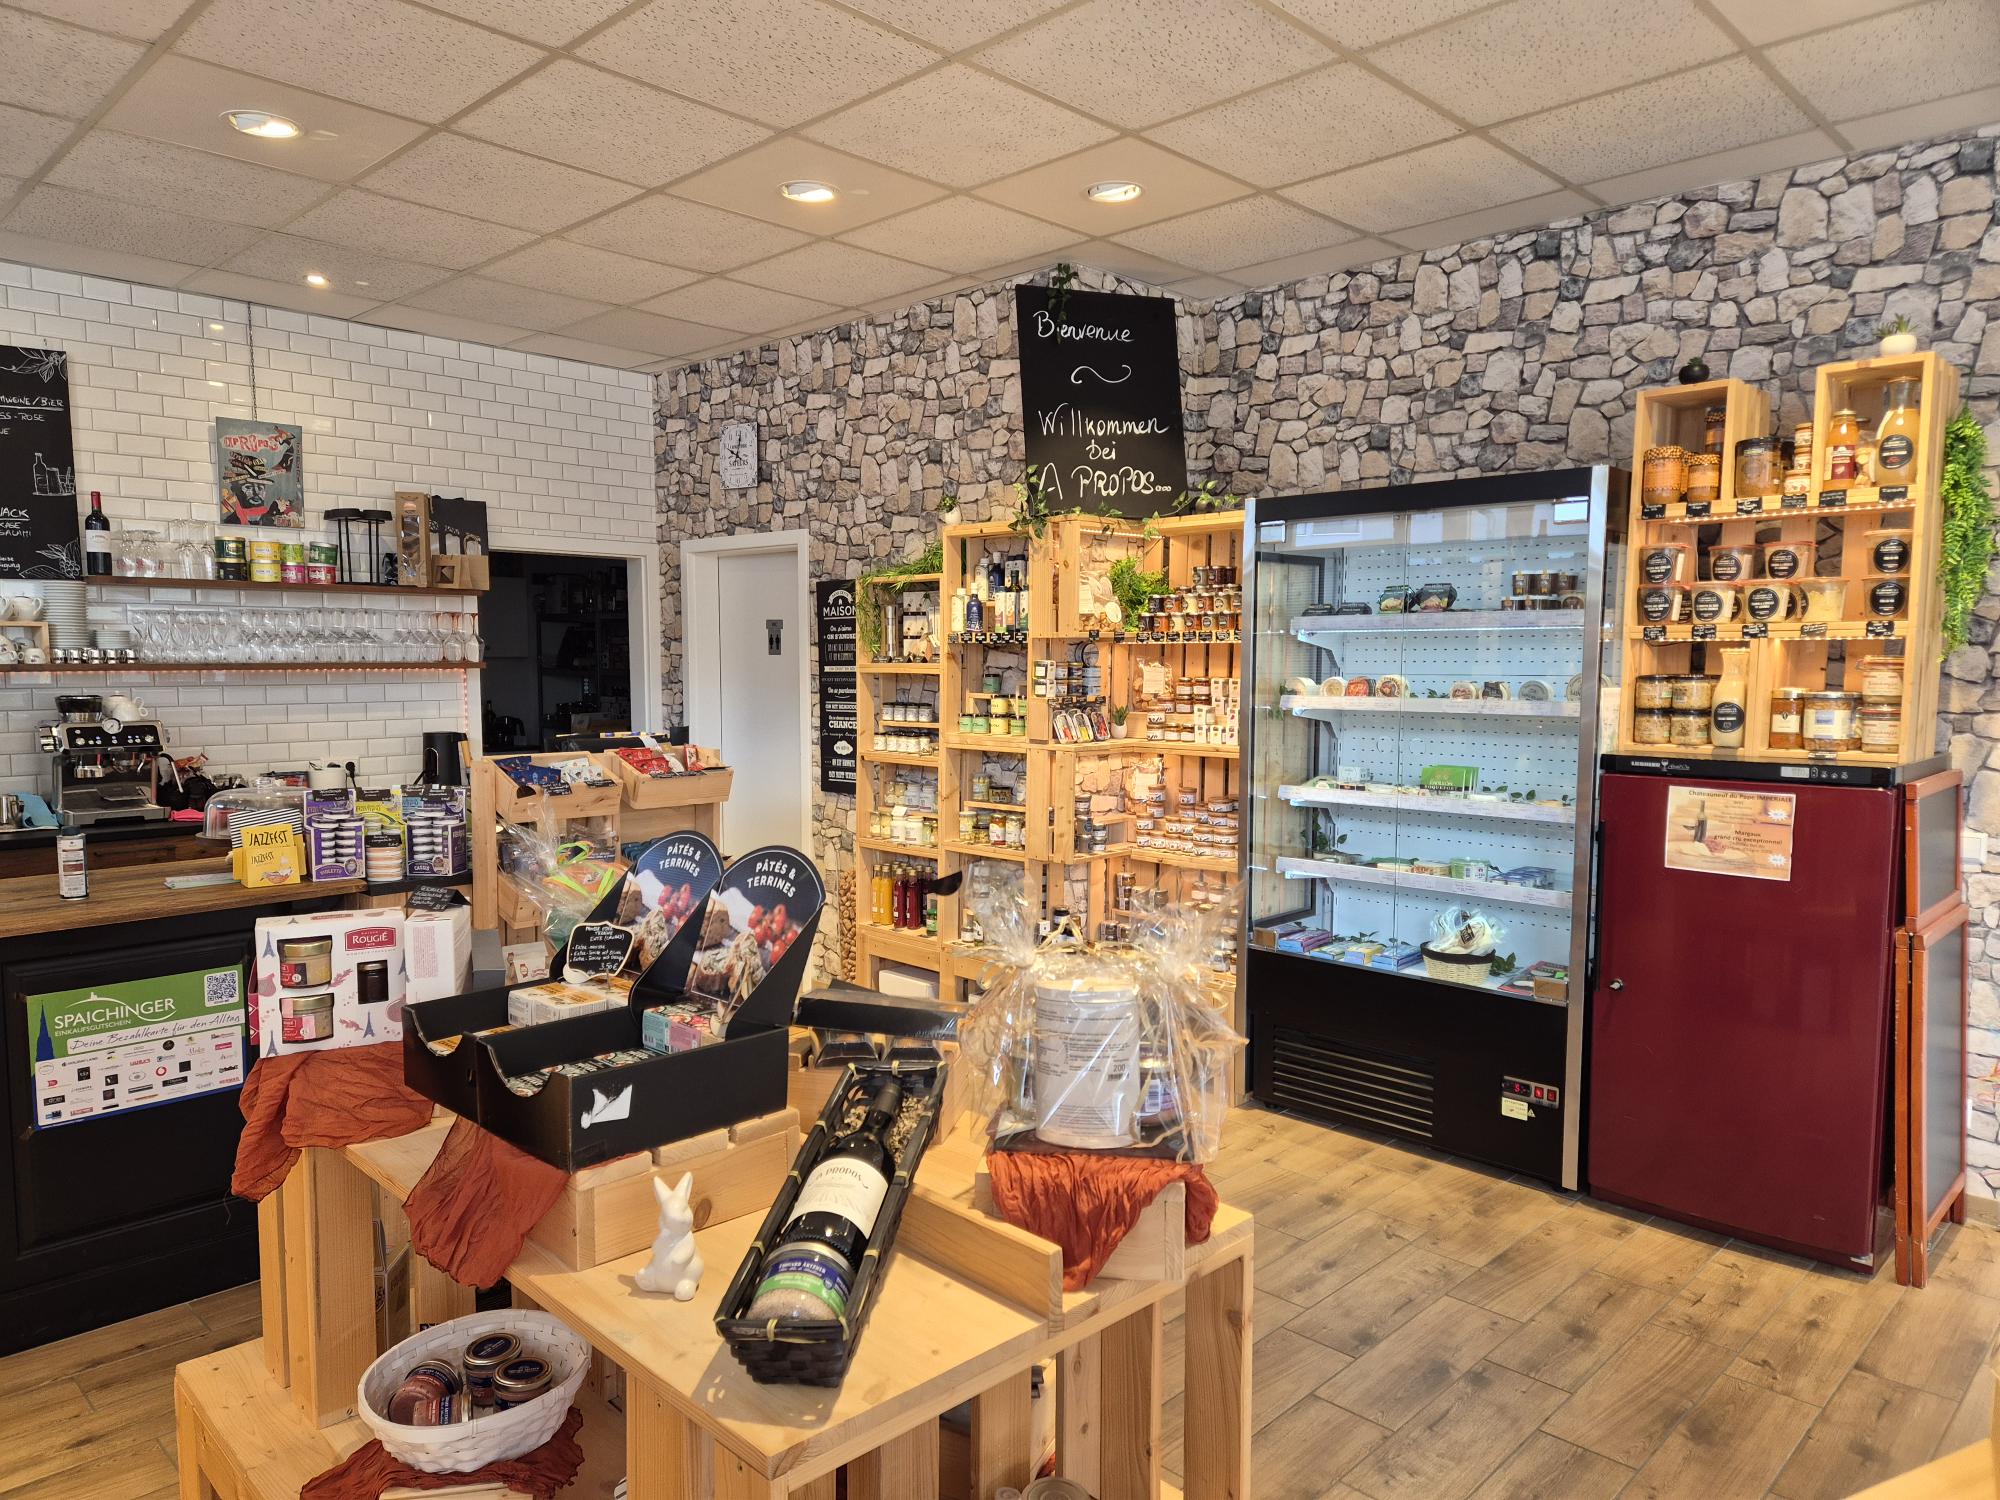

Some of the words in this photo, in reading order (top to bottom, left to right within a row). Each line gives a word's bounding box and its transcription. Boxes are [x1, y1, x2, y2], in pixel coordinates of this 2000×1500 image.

[1033, 310, 1135, 342] Bienvenue
[1038, 403, 1169, 438] Willkommen
[1086, 439, 1116, 460] bei
[249, 830, 288, 847] JAZZFEST
[667, 843, 694, 857] PÂTÉS
[694, 851, 701, 861] &
[659, 857, 700, 877] TERRINES
[756, 859, 787, 875] PÂTÉS
[788, 868, 796, 880] &
[746, 875, 796, 898] TERRINES
[352, 931, 388, 944] ROUGIÉ
[54, 998, 176, 1029] SPAICHINGER
[55, 1019, 131, 1037] EINKAUFSGUTSCHEIN
[70, 1038, 103, 1050] Deine
[106, 1027, 168, 1044] Bezahlkarte
[172, 1023, 187, 1036] für
[191, 1019, 206, 1029] den
[1113, 1063, 1126, 1072] 200
